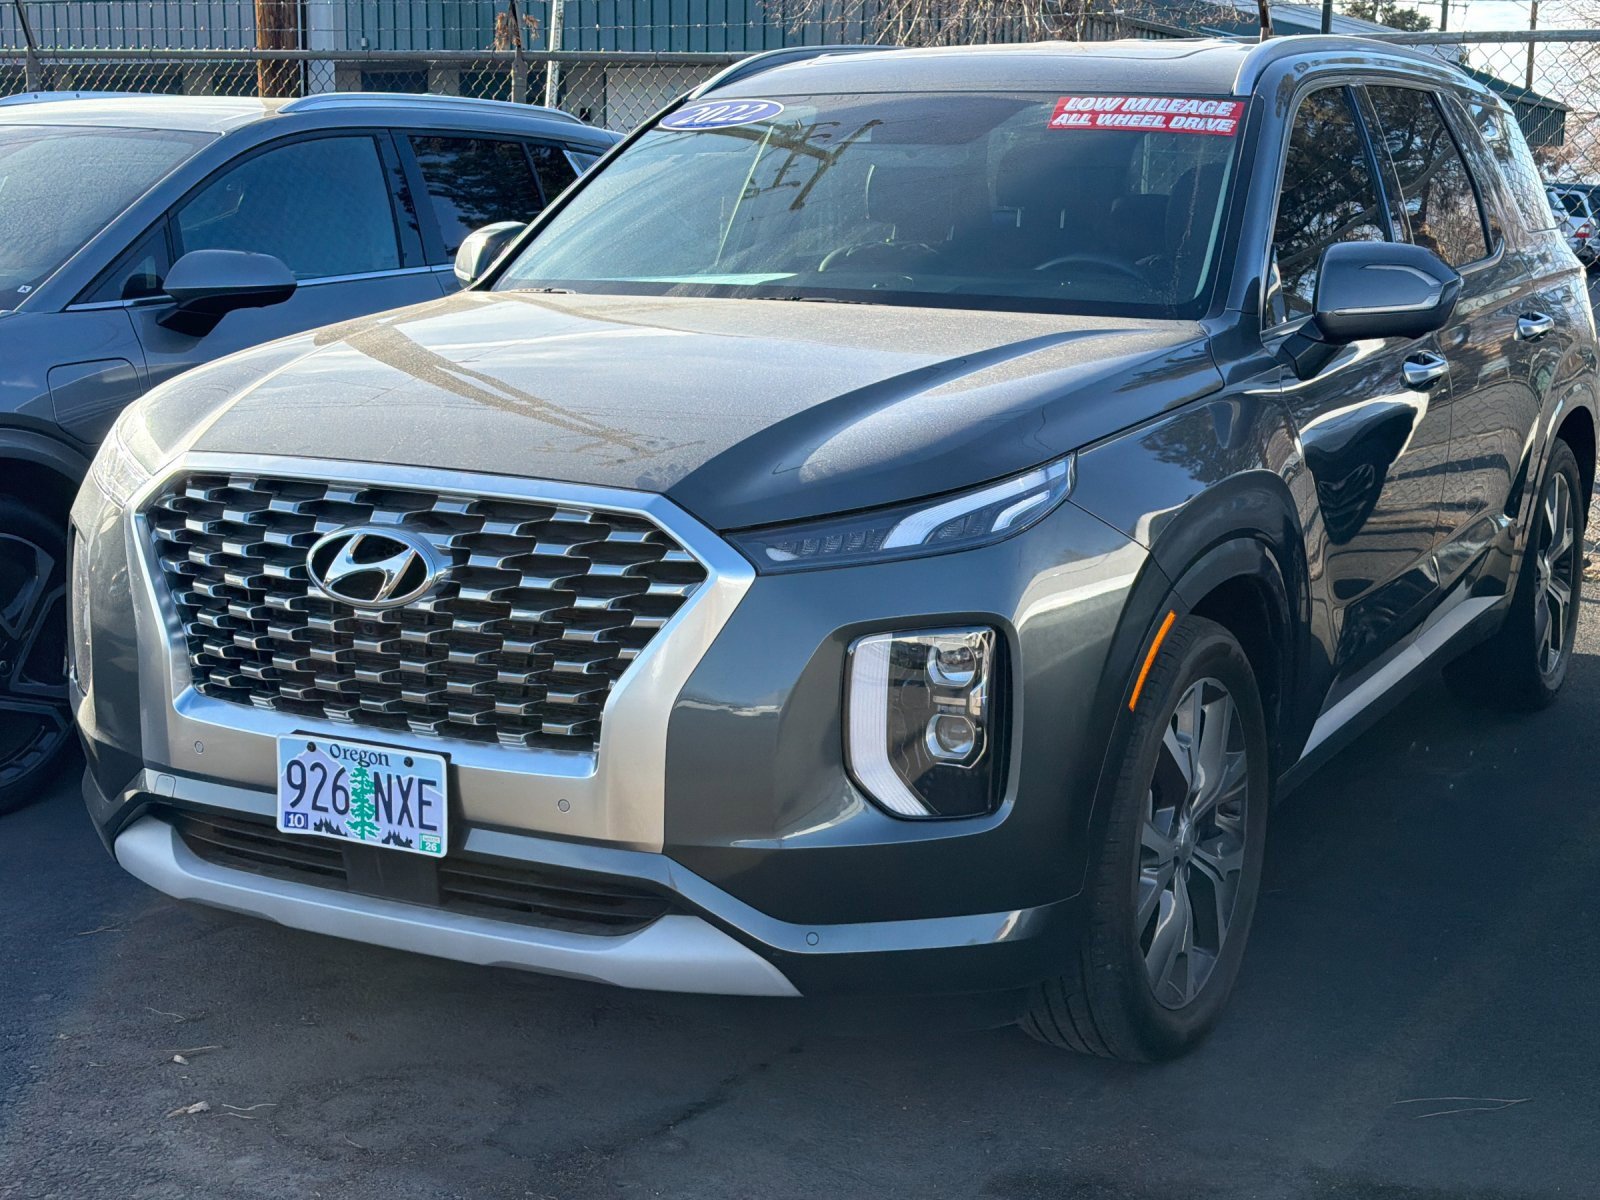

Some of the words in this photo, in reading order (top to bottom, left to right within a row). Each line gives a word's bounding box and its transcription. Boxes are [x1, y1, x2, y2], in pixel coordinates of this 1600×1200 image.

[671, 104, 768, 126] 2022
[1064, 97, 1123, 112] LOW
[1121, 98, 1236, 116] MILEAGE
[1052, 113, 1092, 126] ALL
[1096, 114, 1166, 128] WHEEL
[1169, 116, 1236, 132] DRIVE
[329, 743, 391, 767] Oregon
[286, 759, 350, 815] 926
[373, 771, 438, 831] NXE
[288, 813, 304, 828] 10
[425, 842, 438, 852] 26
